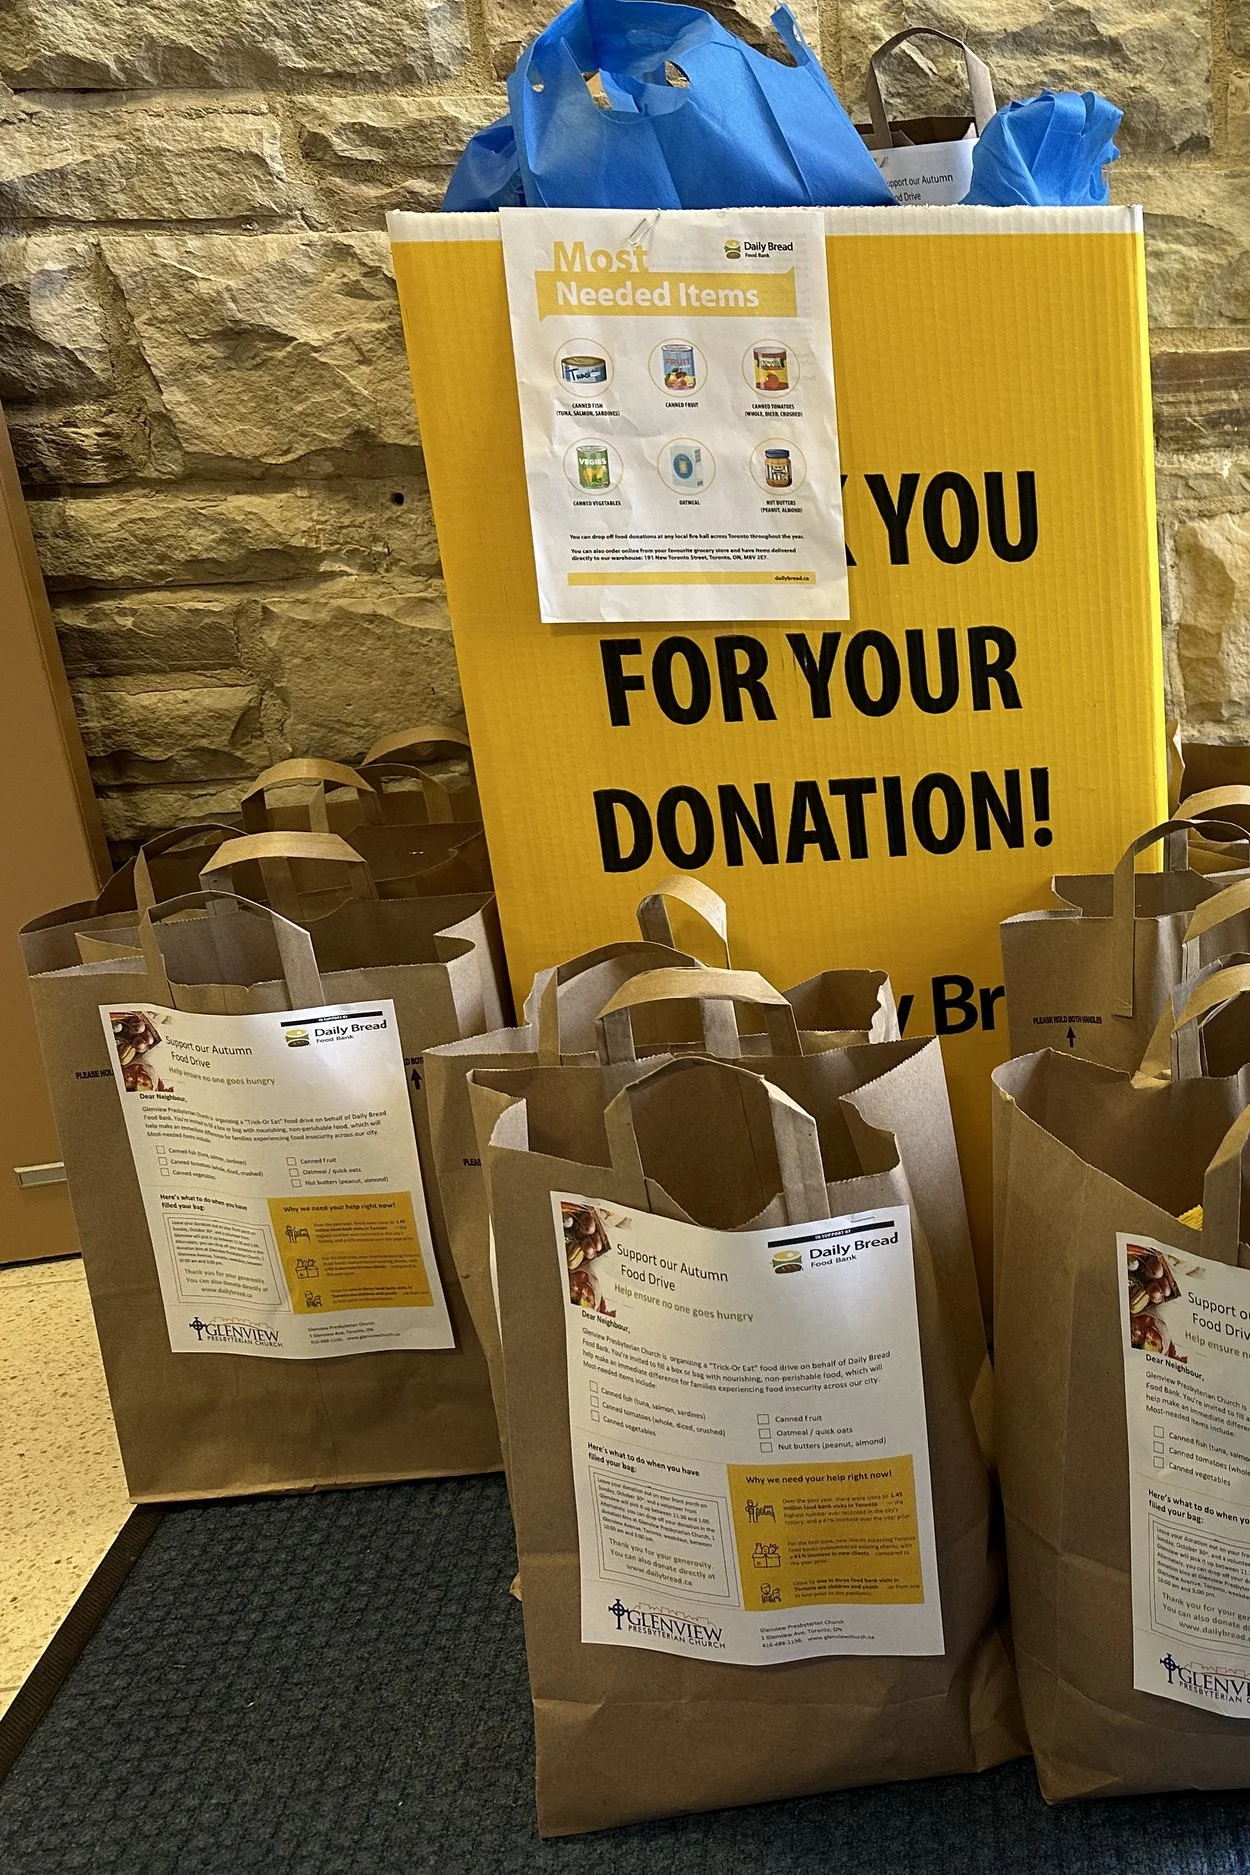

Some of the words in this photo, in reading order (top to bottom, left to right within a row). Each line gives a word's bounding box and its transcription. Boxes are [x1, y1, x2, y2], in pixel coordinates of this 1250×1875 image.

[909, 177, 920, 185] our
[921, 173, 953, 185] Autumn
[904, 193, 921, 202] Drive
[553, 240, 649, 273] Most
[744, 241, 766, 253] Daily
[767, 242, 794, 252] Bread
[556, 280, 670, 307] Needed
[679, 282, 760, 308] Items
[864, 470, 1040, 567] YOU
[599, 633, 777, 727] FOR
[785, 625, 1023, 719] YOUR
[592, 766, 1054, 873] DONATION!
[314, 1024, 348, 1039] Daily
[350, 1019, 387, 1032] Bread
[166, 1035, 194, 1053] Support
[193, 1043, 210, 1055] our
[212, 1046, 253, 1056] Autumn
[171, 1051, 190, 1064] Food
[190, 1057, 211, 1069] Drive
[75, 1070, 100, 1079] PLEASE
[100, 1069, 114, 1077] HOL
[463, 1158, 482, 1166] PLEAS
[809, 1244, 851, 1260] Daily
[854, 1232, 898, 1251] Bread
[616, 1243, 658, 1267] Support
[659, 1256, 678, 1270] our
[680, 1260, 728, 1283] Autumn
[810, 1258, 832, 1268] Food
[835, 1254, 857, 1264] Bank
[620, 1264, 646, 1285] Food
[647, 1272, 676, 1292] Drive
[614, 1283, 633, 1299] Help
[634, 1291, 661, 1306] ensure
[662, 1299, 673, 1310] no
[673, 1303, 691, 1314] one
[692, 1307, 715, 1319] goes
[716, 1311, 754, 1322] hungry
[1188, 1291, 1236, 1318] Support
[204, 1322, 280, 1342] GLENVIEW
[1192, 1313, 1222, 1334] Food
[207, 1335, 252, 1346] PRESBYTERIAN
[254, 1340, 283, 1348] CHURCH
[775, 1415, 802, 1424] Canned
[803, 1414, 822, 1423] fruit
[776, 1429, 808, 1437] Oatmeal
[815, 1427, 835, 1438] quick
[837, 1427, 853, 1435] oats
[778, 1442, 792, 1451] Nut
[793, 1441, 820, 1451] butters
[821, 1439, 853, 1451] (peanut,
[854, 1436, 887, 1448] almond)
[745, 1475, 764, 1485] Why
[782, 1475, 803, 1483] need
[805, 1475, 826, 1485] your
[826, 1473, 846, 1484] help
[847, 1472, 868, 1482] right
[870, 1470, 892, 1480] now!
[609, 1537, 629, 1549] Thank
[630, 1544, 644, 1553] you
[644, 1548, 655, 1556] for
[656, 1552, 672, 1561] your
[673, 1556, 714, 1569] generosity.
[626, 1564, 693, 1586] www.dailybread.ca
[626, 1607, 722, 1642] GLENVIEW
[628, 1625, 687, 1645] PRESBYTERIAN
[689, 1637, 726, 1649] CHURCH
[1179, 1681, 1243, 1704] PRESBYTERIAN
